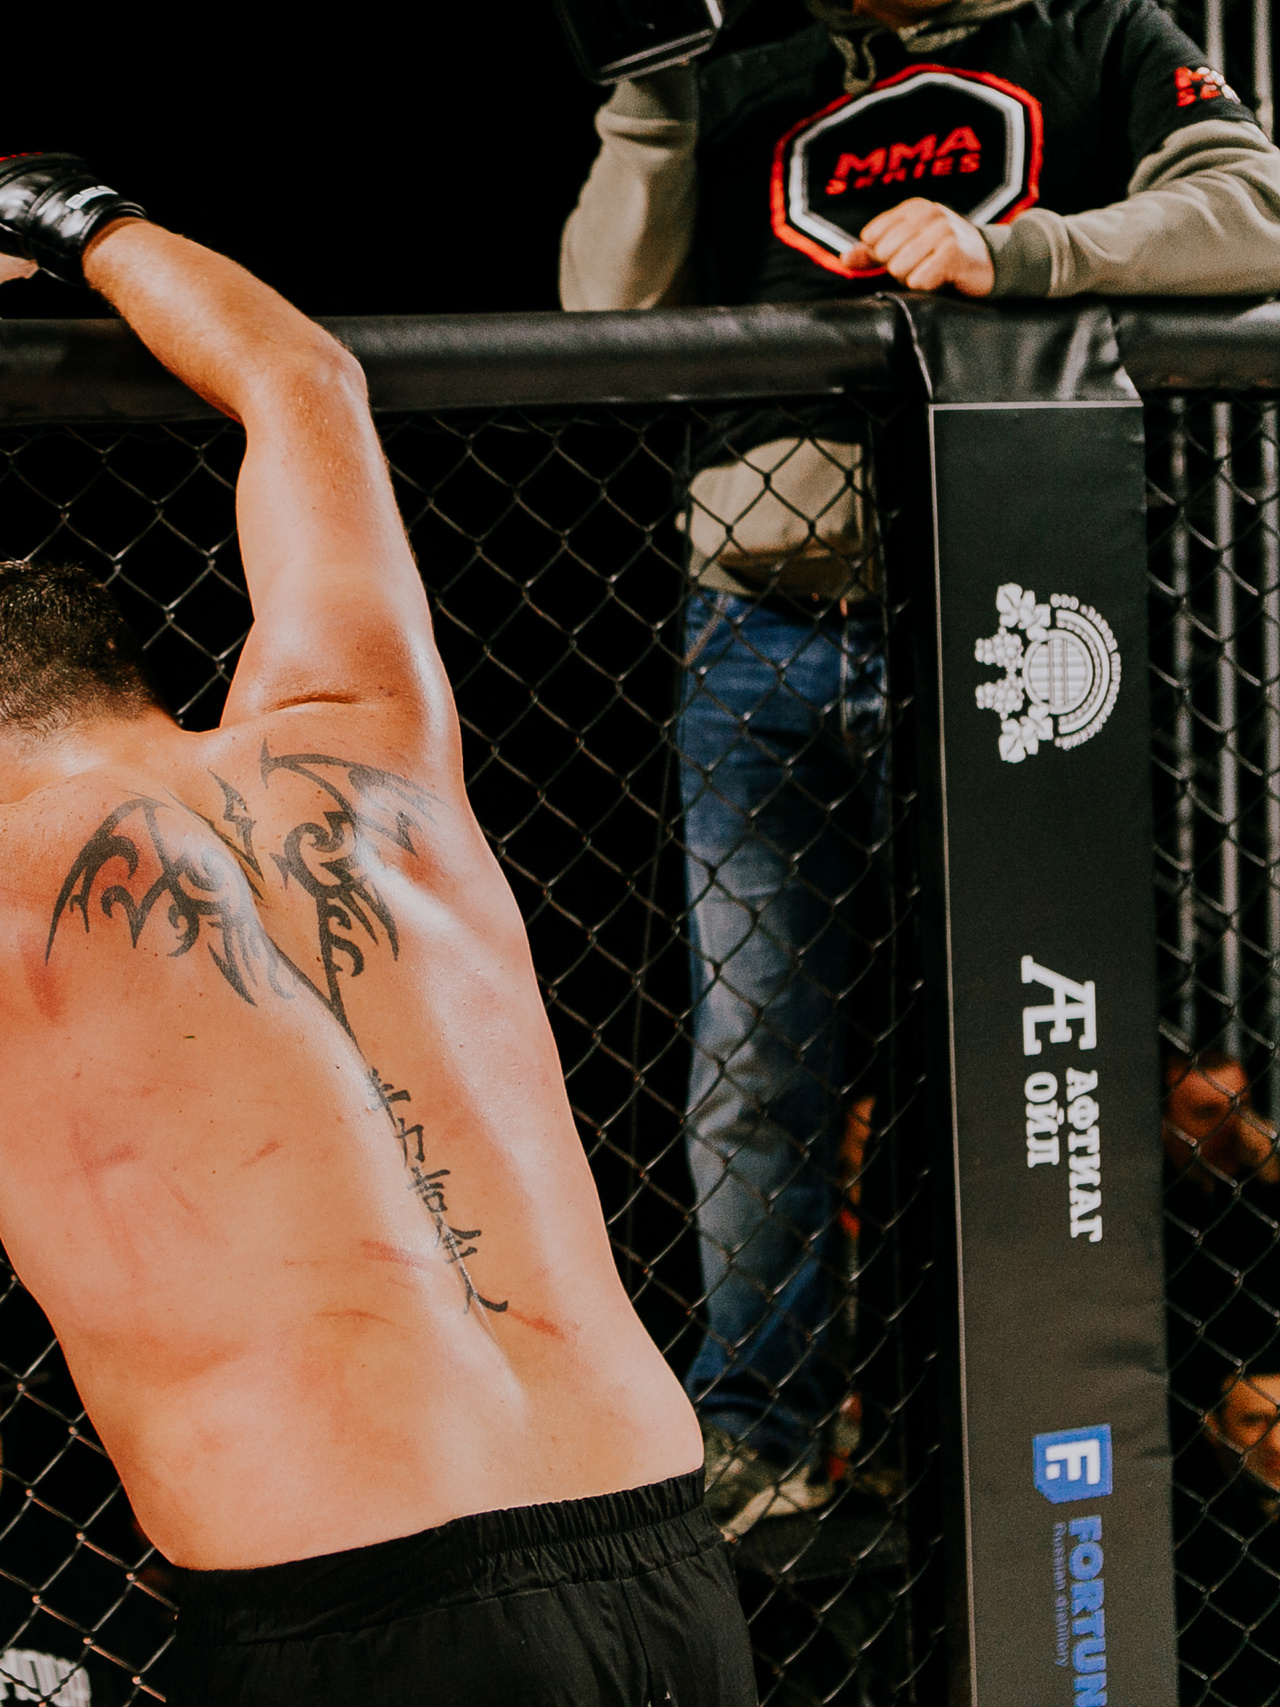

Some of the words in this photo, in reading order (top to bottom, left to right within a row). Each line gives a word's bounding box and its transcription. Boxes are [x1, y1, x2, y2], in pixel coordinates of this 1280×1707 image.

[834, 125, 982, 178] MMA
[1024, 1071, 1063, 1169] ОЙЛ
[1066, 1067, 1103, 1243] АФТИАГ
[1053, 1522, 1067, 1590] Russian
